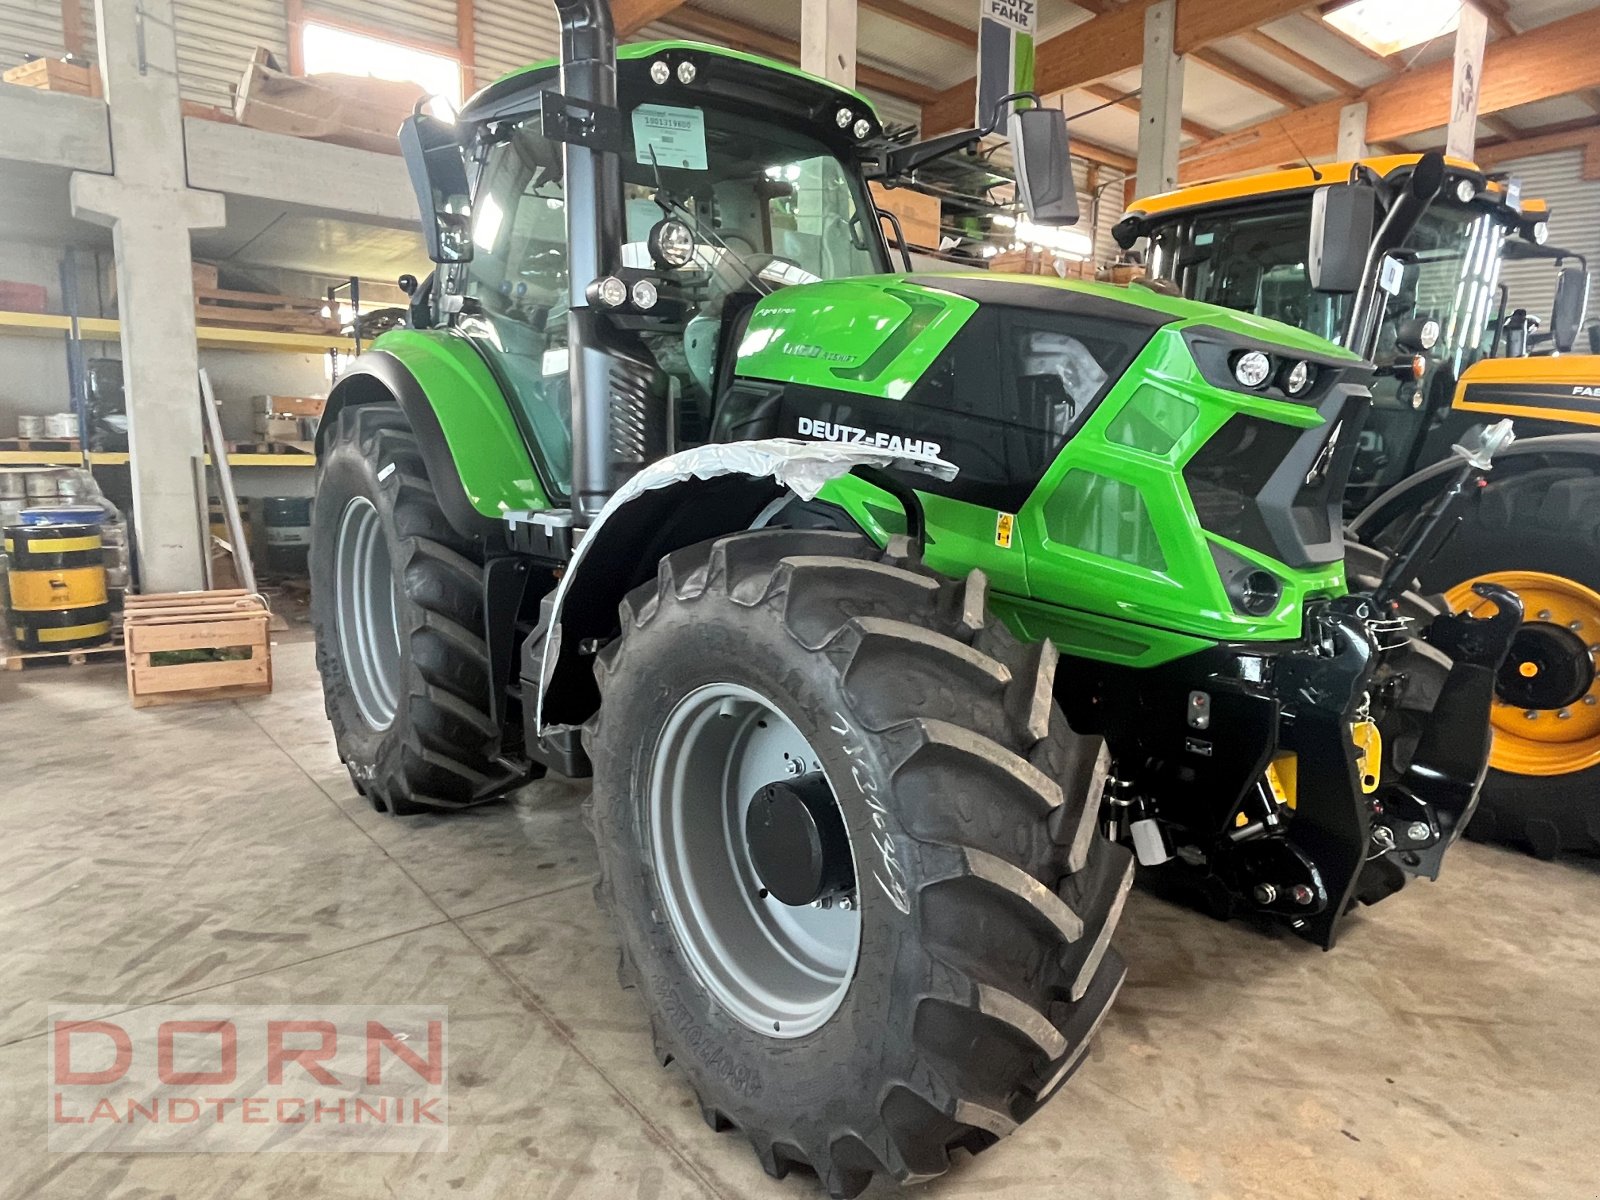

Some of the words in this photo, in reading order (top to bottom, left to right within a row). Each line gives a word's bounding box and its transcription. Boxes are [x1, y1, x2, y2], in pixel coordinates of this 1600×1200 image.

[992, 1, 1028, 26] FAHR
[999, 0, 1034, 14] UTZ
[798, 416, 941, 460] DEUTZ-FAHR
